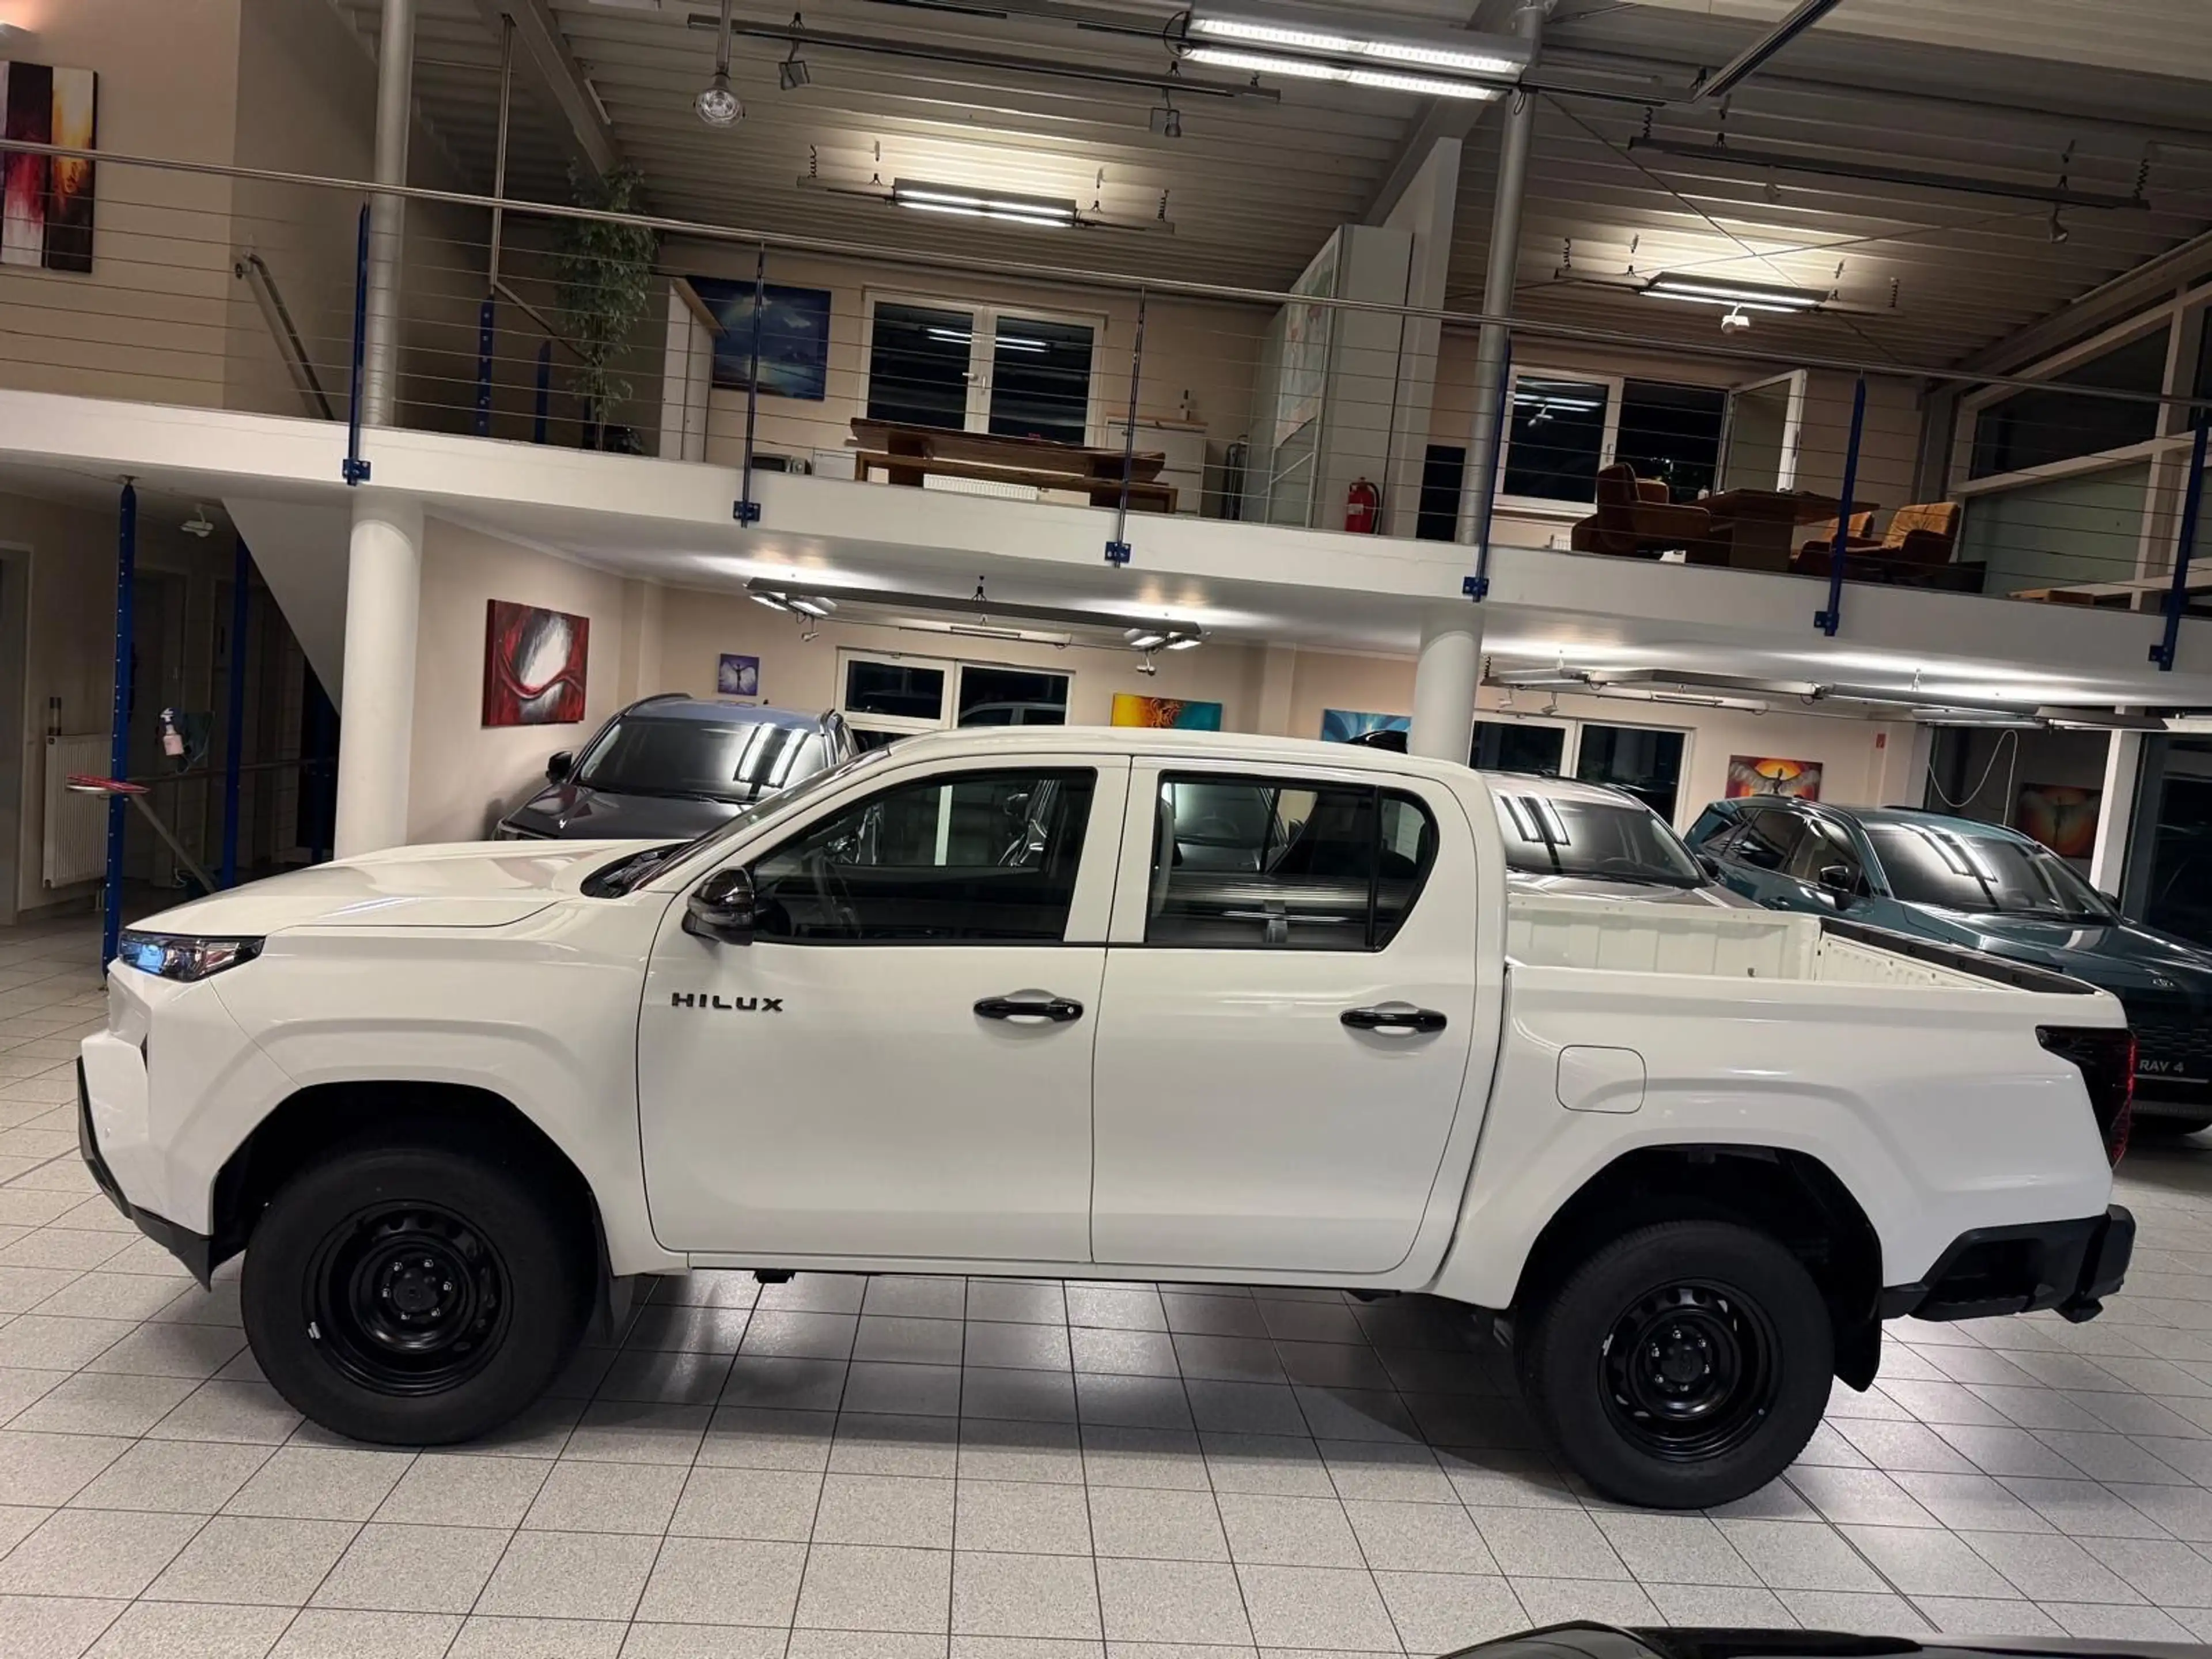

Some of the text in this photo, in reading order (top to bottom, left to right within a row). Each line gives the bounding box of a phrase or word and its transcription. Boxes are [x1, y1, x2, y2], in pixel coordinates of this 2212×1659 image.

[672, 993, 783, 1012] HILUX
[2139, 1059, 2184, 1073] RAV 4
